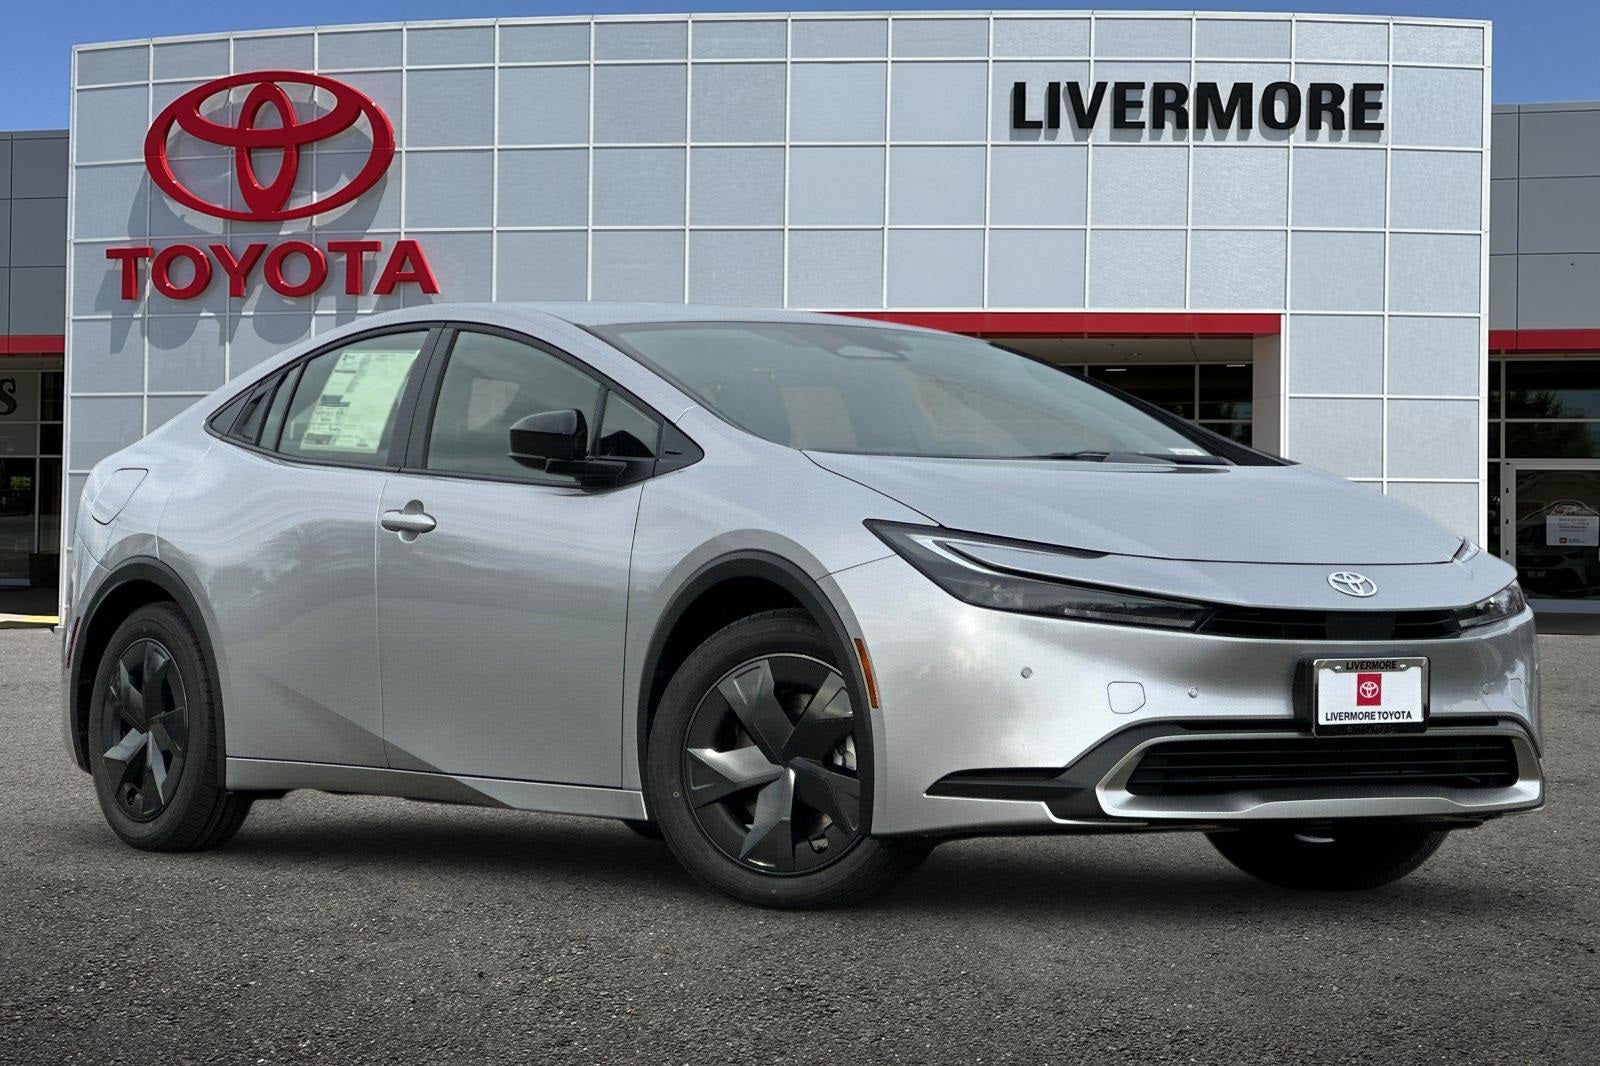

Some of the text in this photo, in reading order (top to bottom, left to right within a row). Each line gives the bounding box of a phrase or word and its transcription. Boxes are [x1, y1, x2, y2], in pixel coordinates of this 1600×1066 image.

[1012, 81, 1384, 130] LIVERMORE
[106, 240, 440, 300] TOYOTA
[1346, 661, 1397, 670] LIVERMORE
[1325, 711, 1412, 721] LIVERMORE TOYOTA
